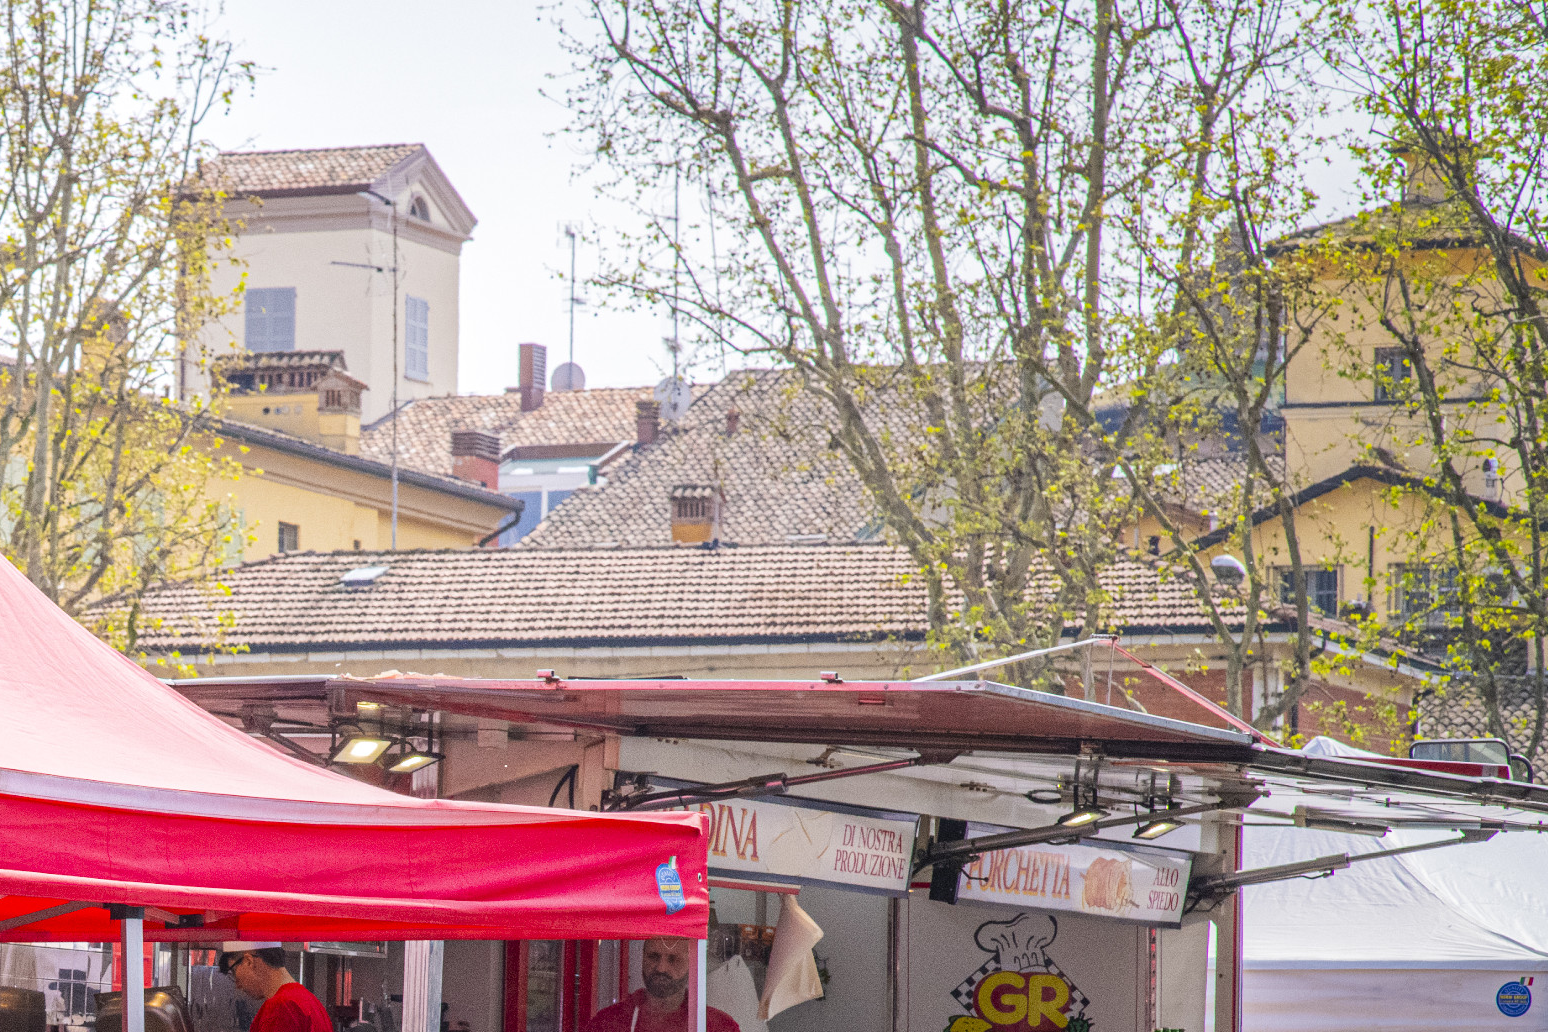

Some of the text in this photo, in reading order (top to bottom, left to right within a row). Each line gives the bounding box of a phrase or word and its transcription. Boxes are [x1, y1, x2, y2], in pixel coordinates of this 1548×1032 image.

[699, 802, 760, 862] DINA
[843, 824, 902, 854] DI NOSTRA
[834, 850, 906, 880] PRODUZIONE
[1153, 867, 1180, 888] ALLO
[1147, 889, 1180, 913] SPIEDO
[978, 971, 1070, 1029] GR
